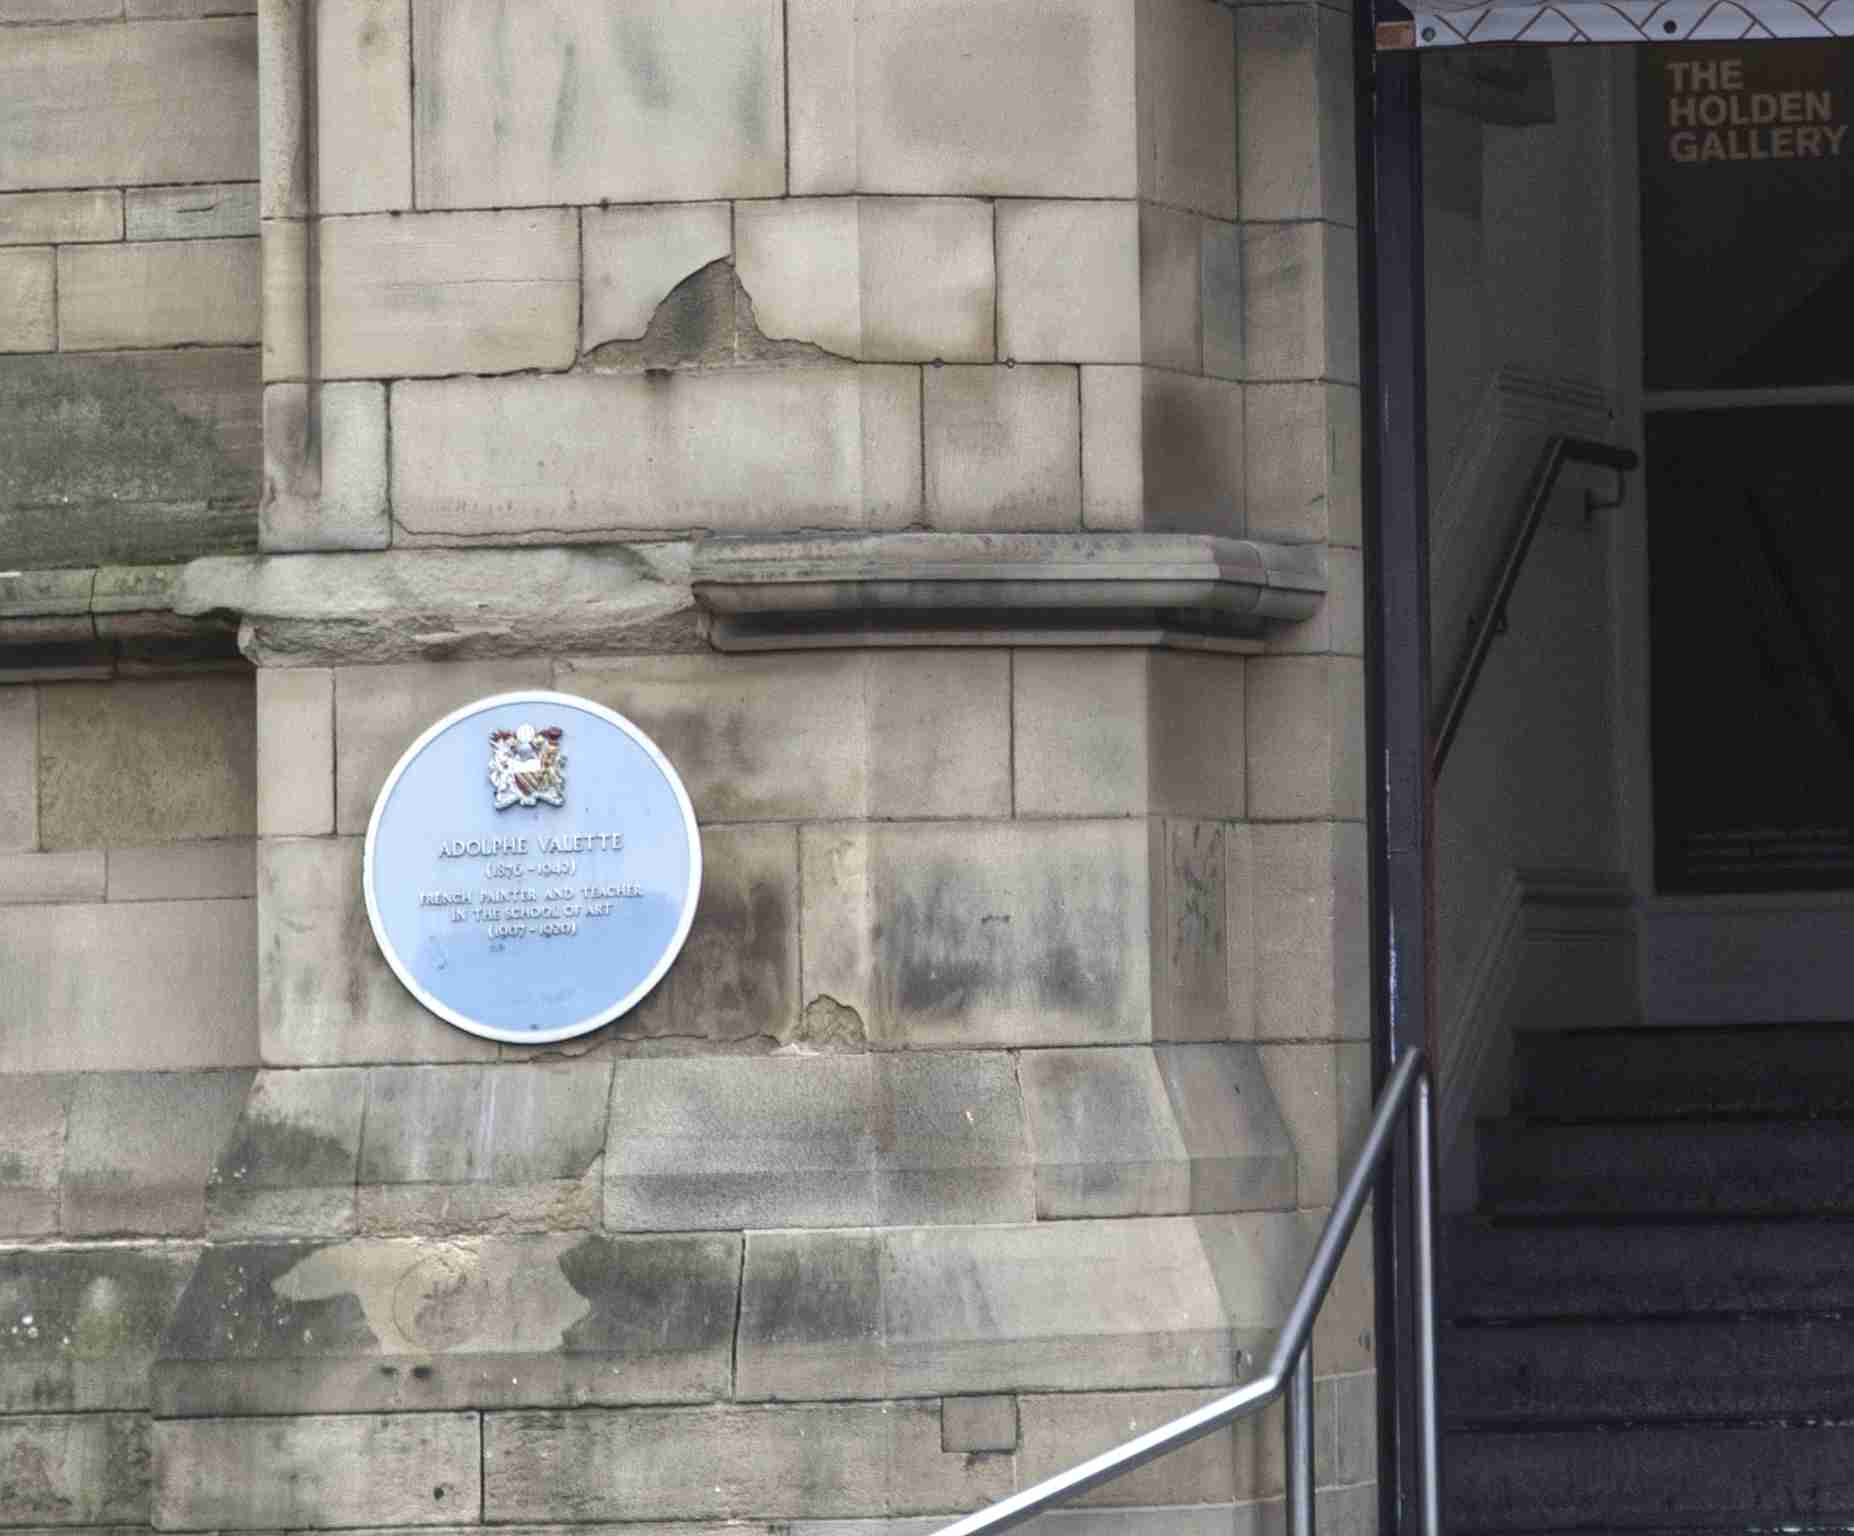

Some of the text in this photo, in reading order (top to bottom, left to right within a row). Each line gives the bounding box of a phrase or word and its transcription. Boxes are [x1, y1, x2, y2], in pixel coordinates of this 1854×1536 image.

[1667, 59, 1745, 93] THE
[1668, 90, 1833, 127] HOLDEN
[1669, 125, 1849, 163] GALLERY
[439, 838, 529, 859] ADOLPHE
[505, 905, 561, 921] SCHOOL
